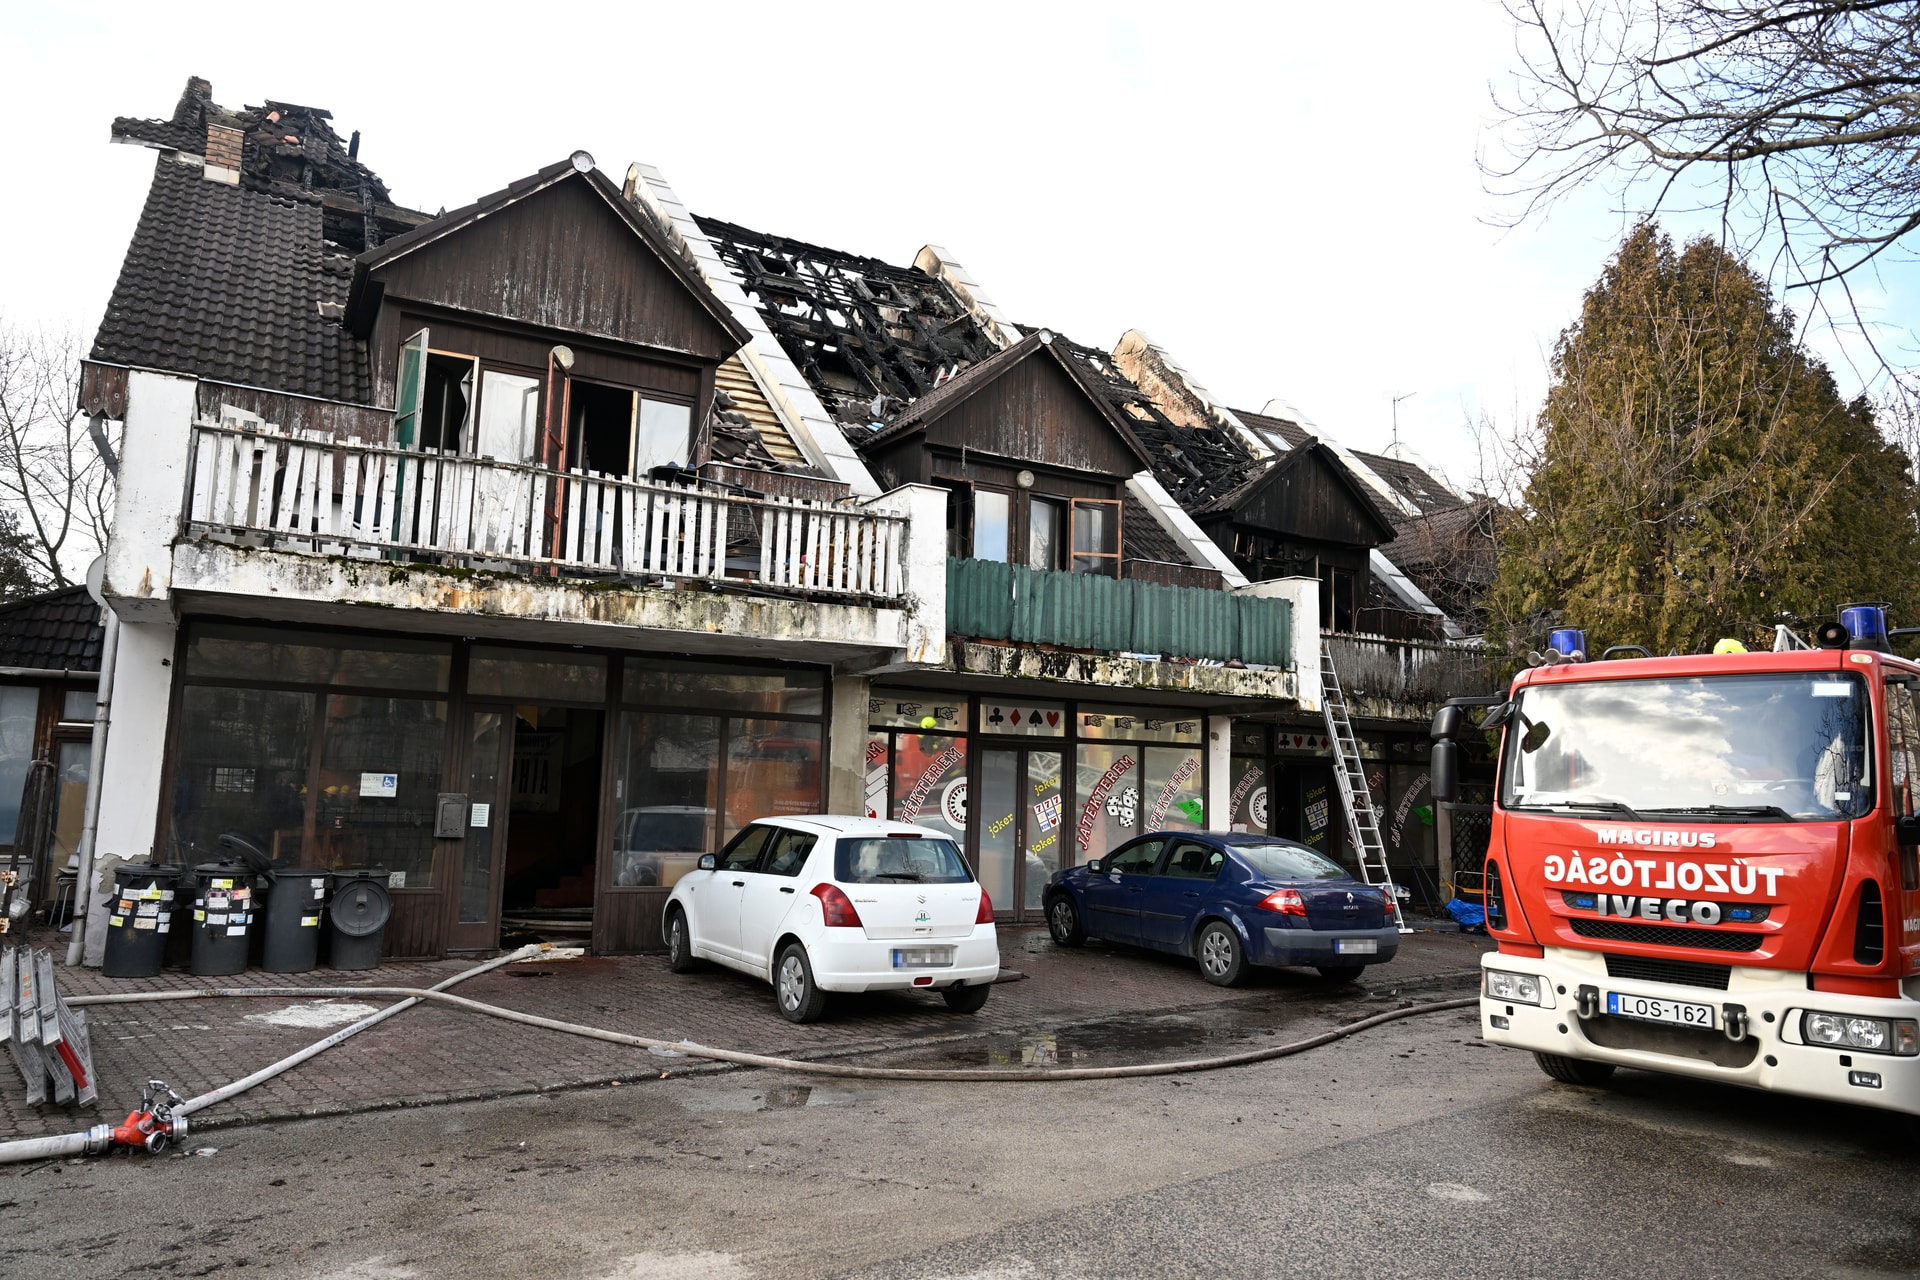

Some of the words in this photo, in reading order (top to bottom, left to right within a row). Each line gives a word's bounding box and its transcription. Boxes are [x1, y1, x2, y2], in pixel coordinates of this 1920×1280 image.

[1036, 805, 1041, 813] 7
[1075, 754, 1137, 851] JÁTÉKTEREM
[1597, 828, 1716, 849] MAGIRUS
[1597, 893, 1721, 925] IVECO
[1622, 997, 1707, 1024] LOS-162
